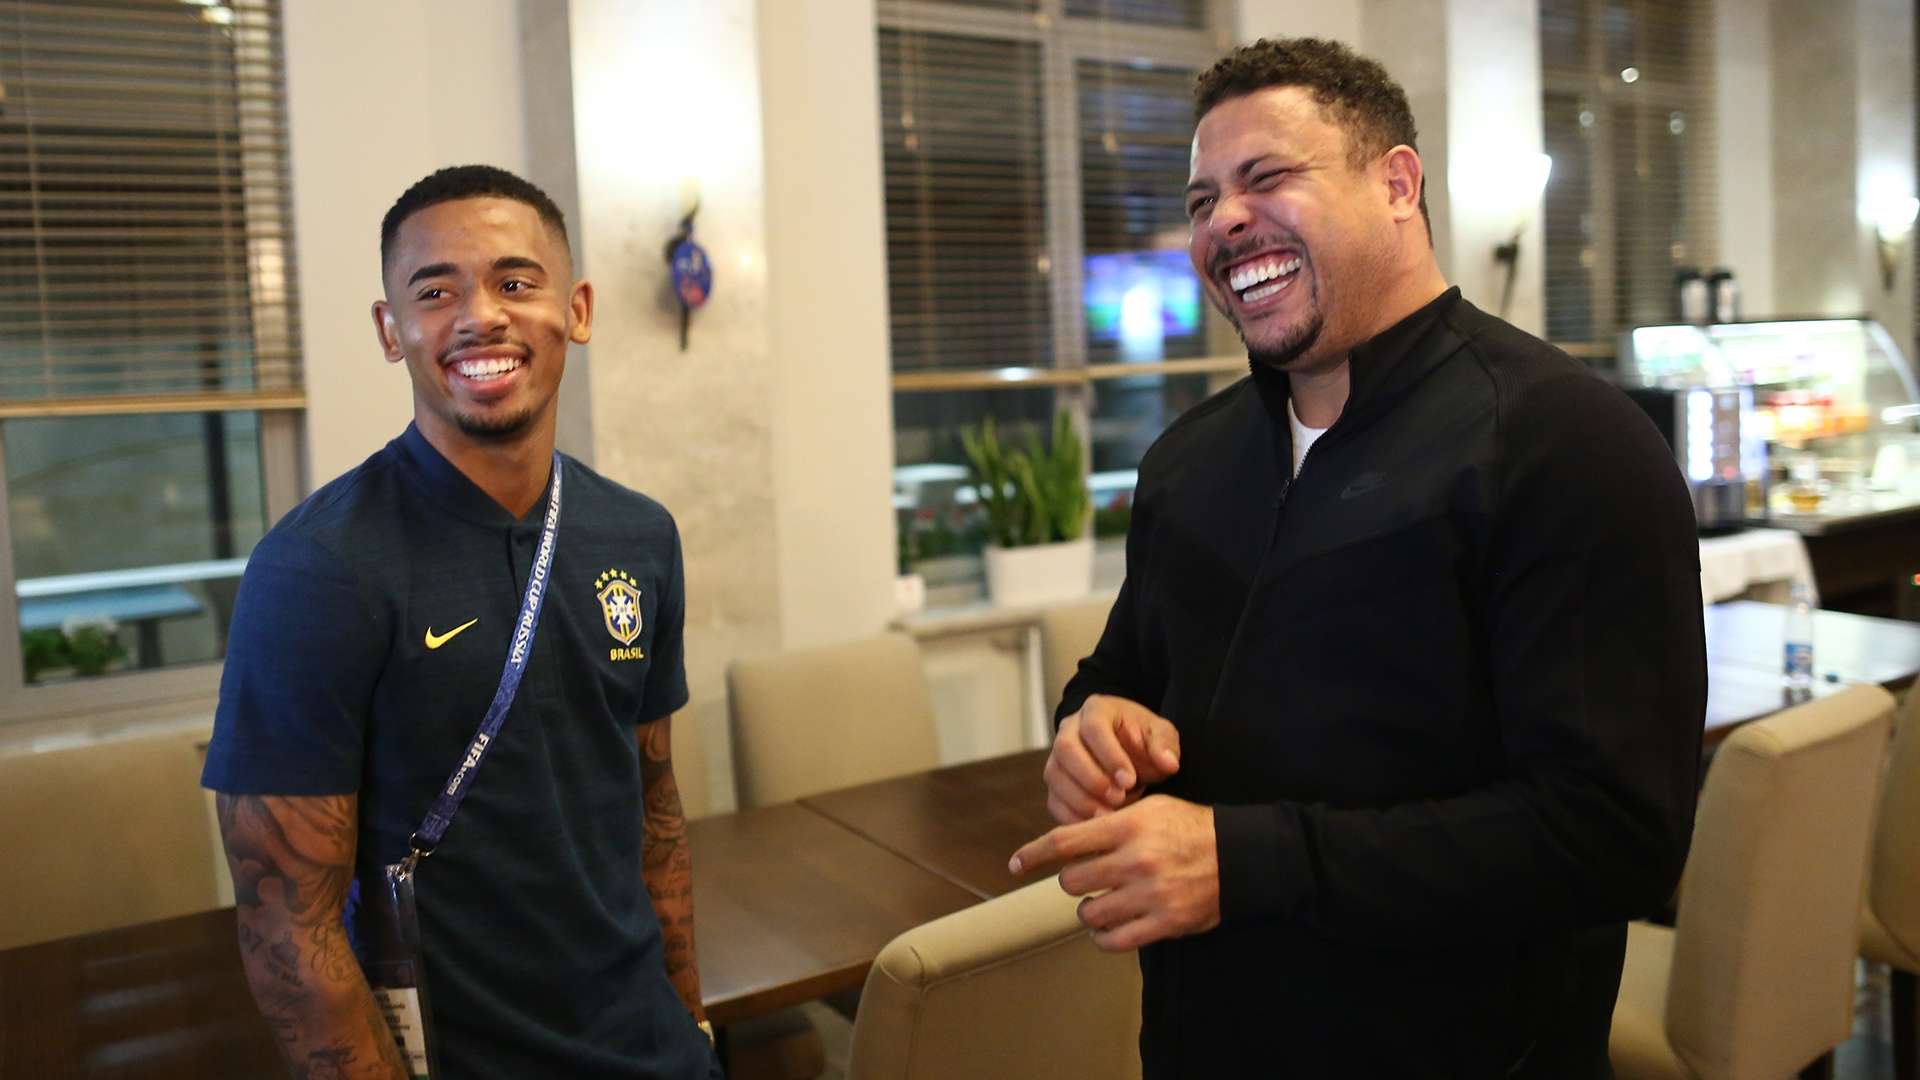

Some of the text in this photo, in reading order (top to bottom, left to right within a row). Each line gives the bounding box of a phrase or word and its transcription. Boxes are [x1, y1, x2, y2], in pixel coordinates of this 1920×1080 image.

[546, 501, 559, 529] FIFA
[535, 530, 554, 580] WORLD
[528, 579, 542, 611] CUP
[511, 609, 534, 664] RUSSIA
[610, 647, 645, 662] BRASIL
[446, 732, 490, 796] FIFA.com
